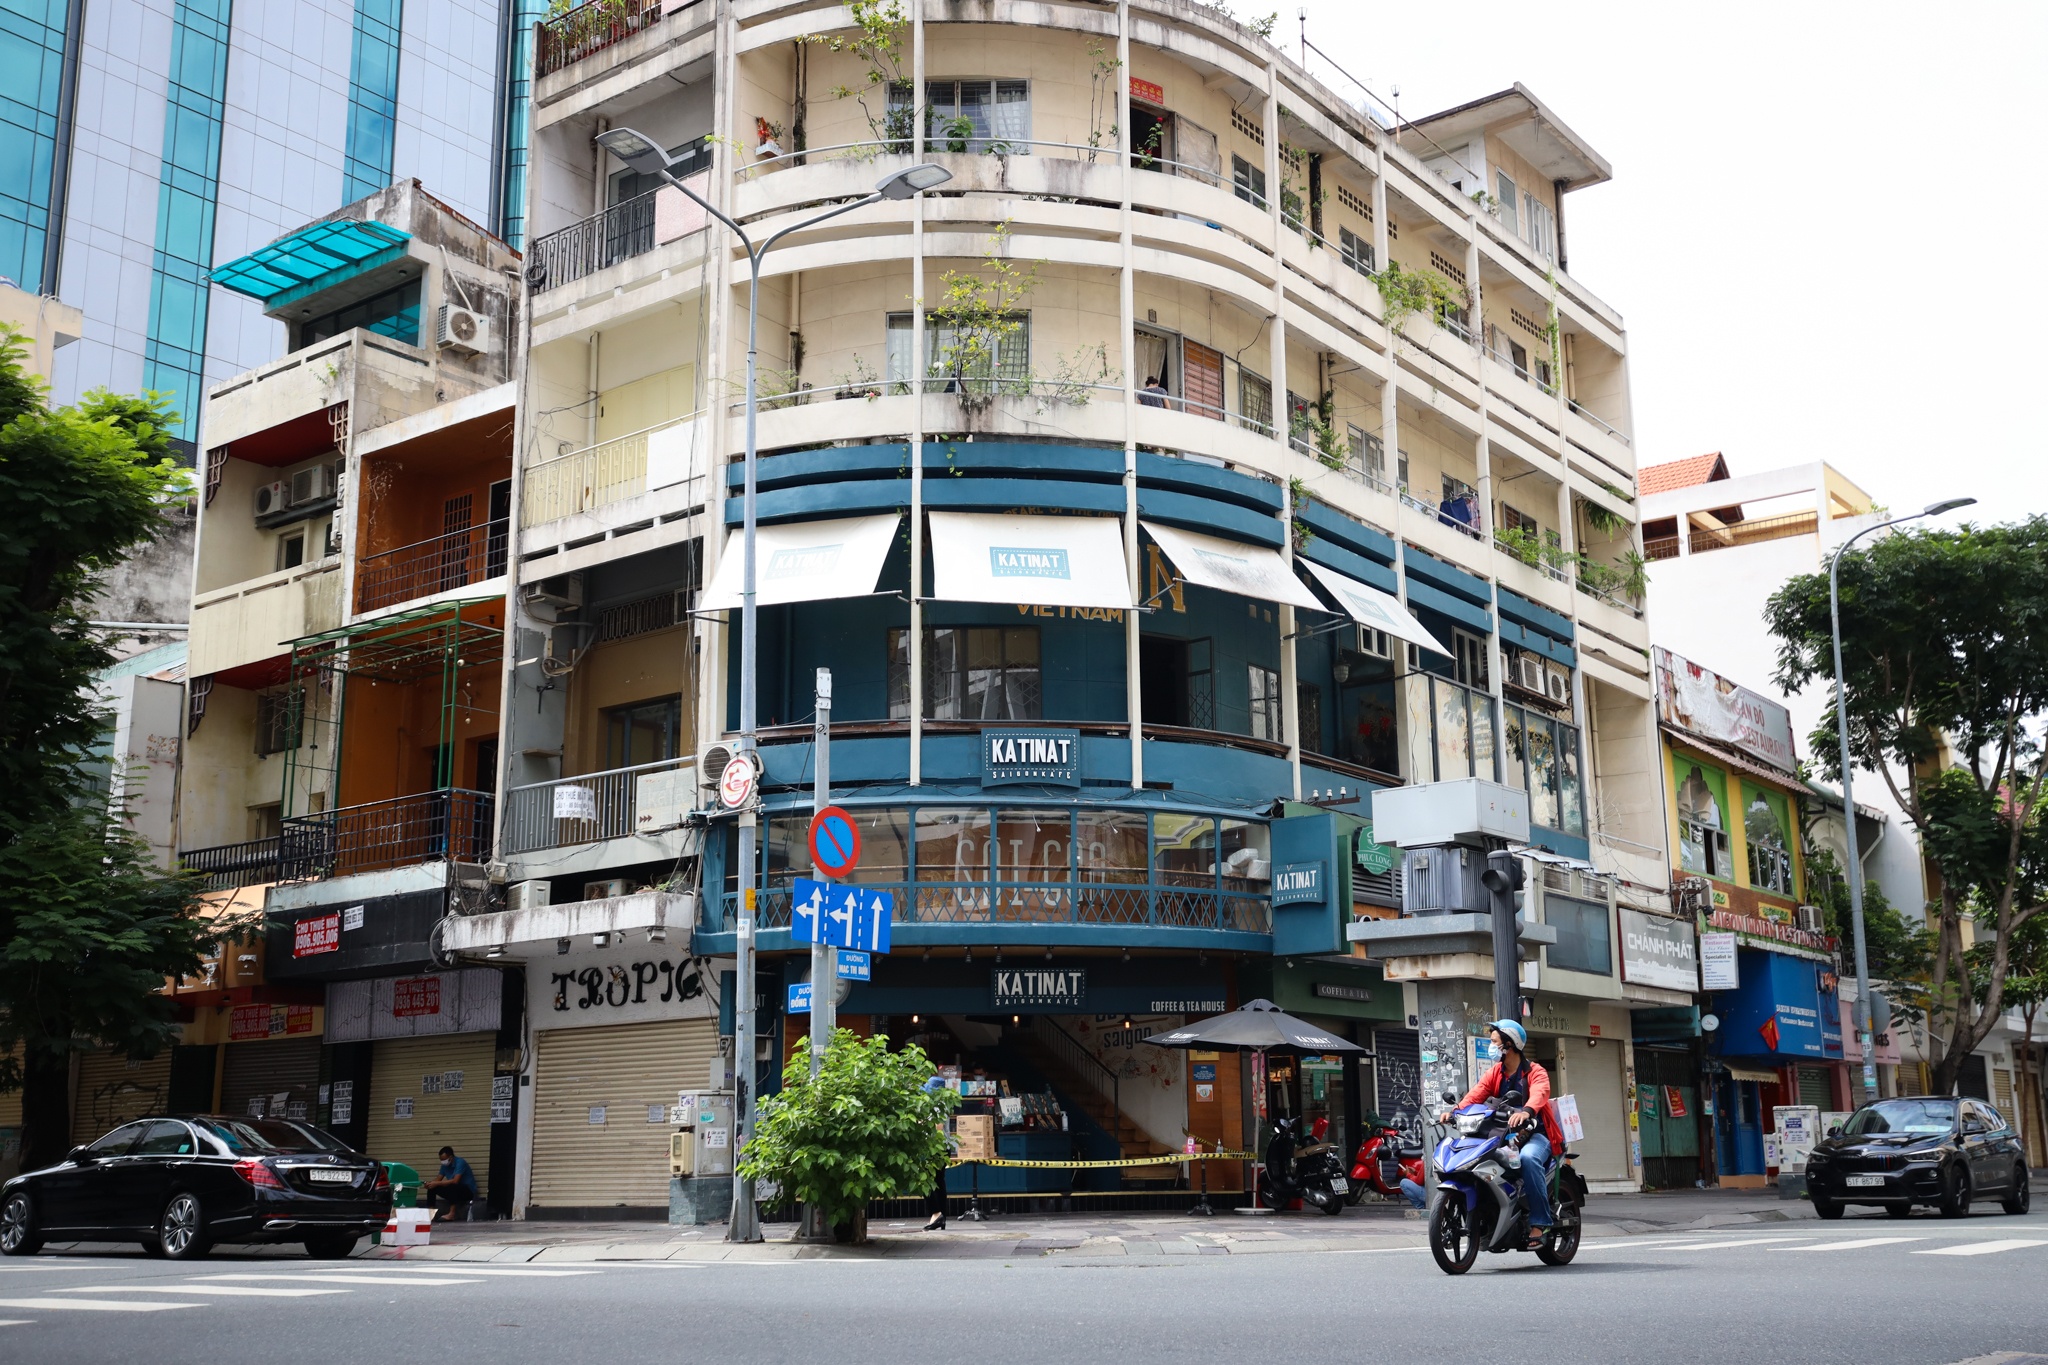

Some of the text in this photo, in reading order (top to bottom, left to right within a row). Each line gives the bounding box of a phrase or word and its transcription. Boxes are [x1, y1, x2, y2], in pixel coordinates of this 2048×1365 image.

[998, 553, 1059, 568] KATINAT
[992, 739, 1071, 763] KATINAT
[1375, 855, 1392, 868] LONG
[1277, 870, 1317, 891] KATINAT
[296, 922, 308, 935] CHO
[310, 917, 325, 932] THUÊ
[326, 913, 339, 928] NHÀ
[295, 928, 339, 950] 0906.905.006
[1628, 932, 1693, 960] CHÁNH PHÁT
[838, 964, 849, 975] MẠC
[850, 965, 858, 976] THỊ
[551, 957, 706, 1012] TROPIC
[998, 972, 1081, 995] KATINAT
[1321, 985, 1347, 996] COFFEE
[1356, 990, 1369, 999] TEA
[1151, 1001, 1225, 1012] COFFEE & TEA HOUSE
[1531, 1015, 1570, 1030] COSETTE
